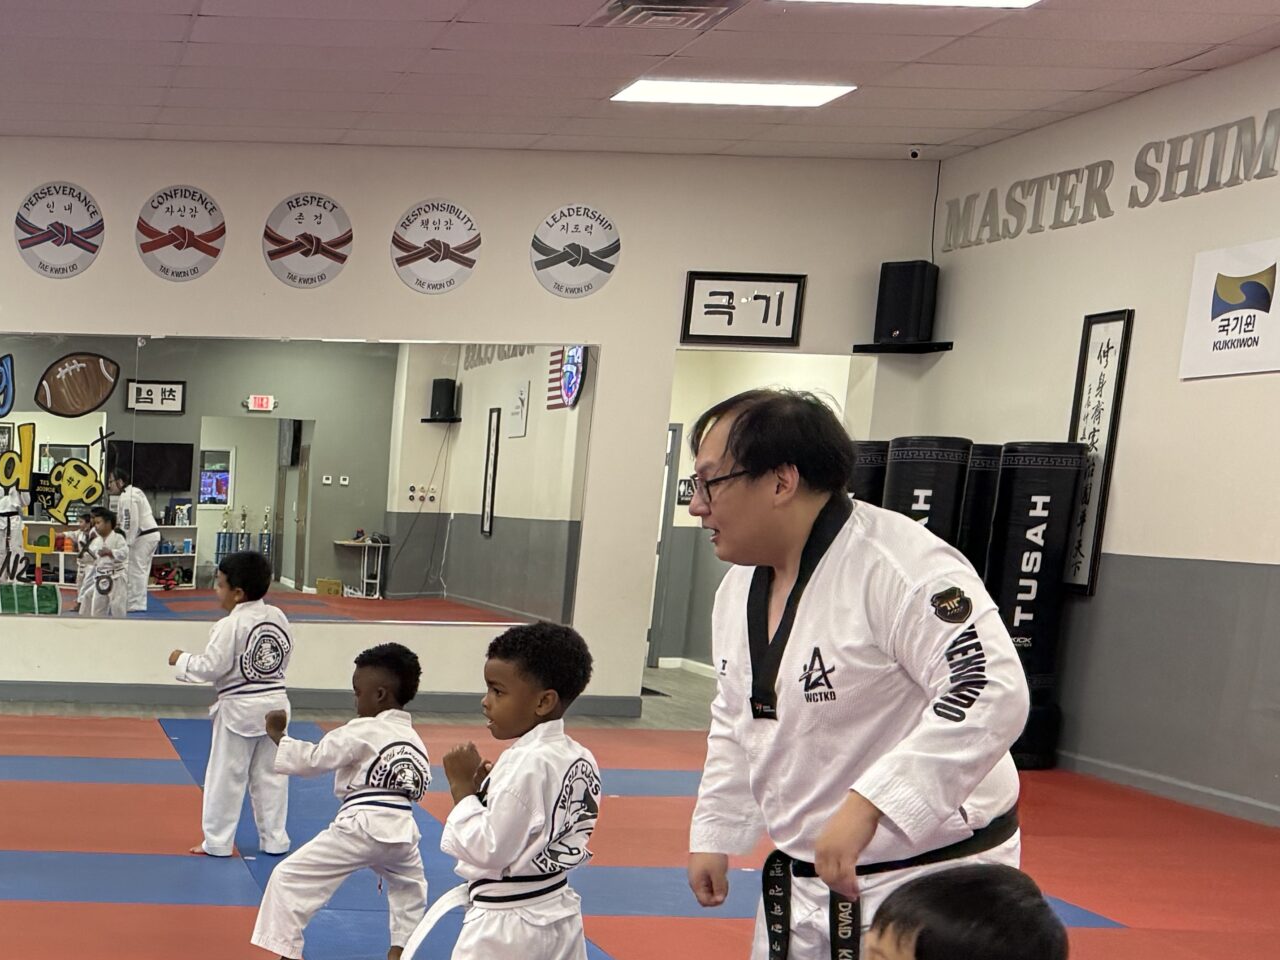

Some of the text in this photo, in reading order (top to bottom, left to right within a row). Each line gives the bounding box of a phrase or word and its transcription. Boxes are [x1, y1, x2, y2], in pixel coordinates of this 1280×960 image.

[942, 107, 1280, 252] MASTER SHIM
[23, 185, 99, 219] PERSEVERANCE
[150, 188, 218, 217] CONFIDENCE
[286, 195, 338, 213] RESPECT
[401, 202, 477, 232] RESPONSIBILITY
[545, 206, 613, 232] LEADERSHIP
[38, 261, 78, 275] TAE KWON DO
[159, 265, 199, 278] TAE KWON DO
[286, 272, 327, 285] TAE KWON DO
[414, 278, 455, 290] TAE KWON DO
[552, 281, 593, 295] TAE KWON DO
[1218, 314, 1256, 336] 국기원
[1213, 336, 1259, 352] KUKKIWON
[65, 474, 82, 490] #1
[1013, 495, 1051, 627] TUSAH
[804, 690, 836, 703] WCTKD
